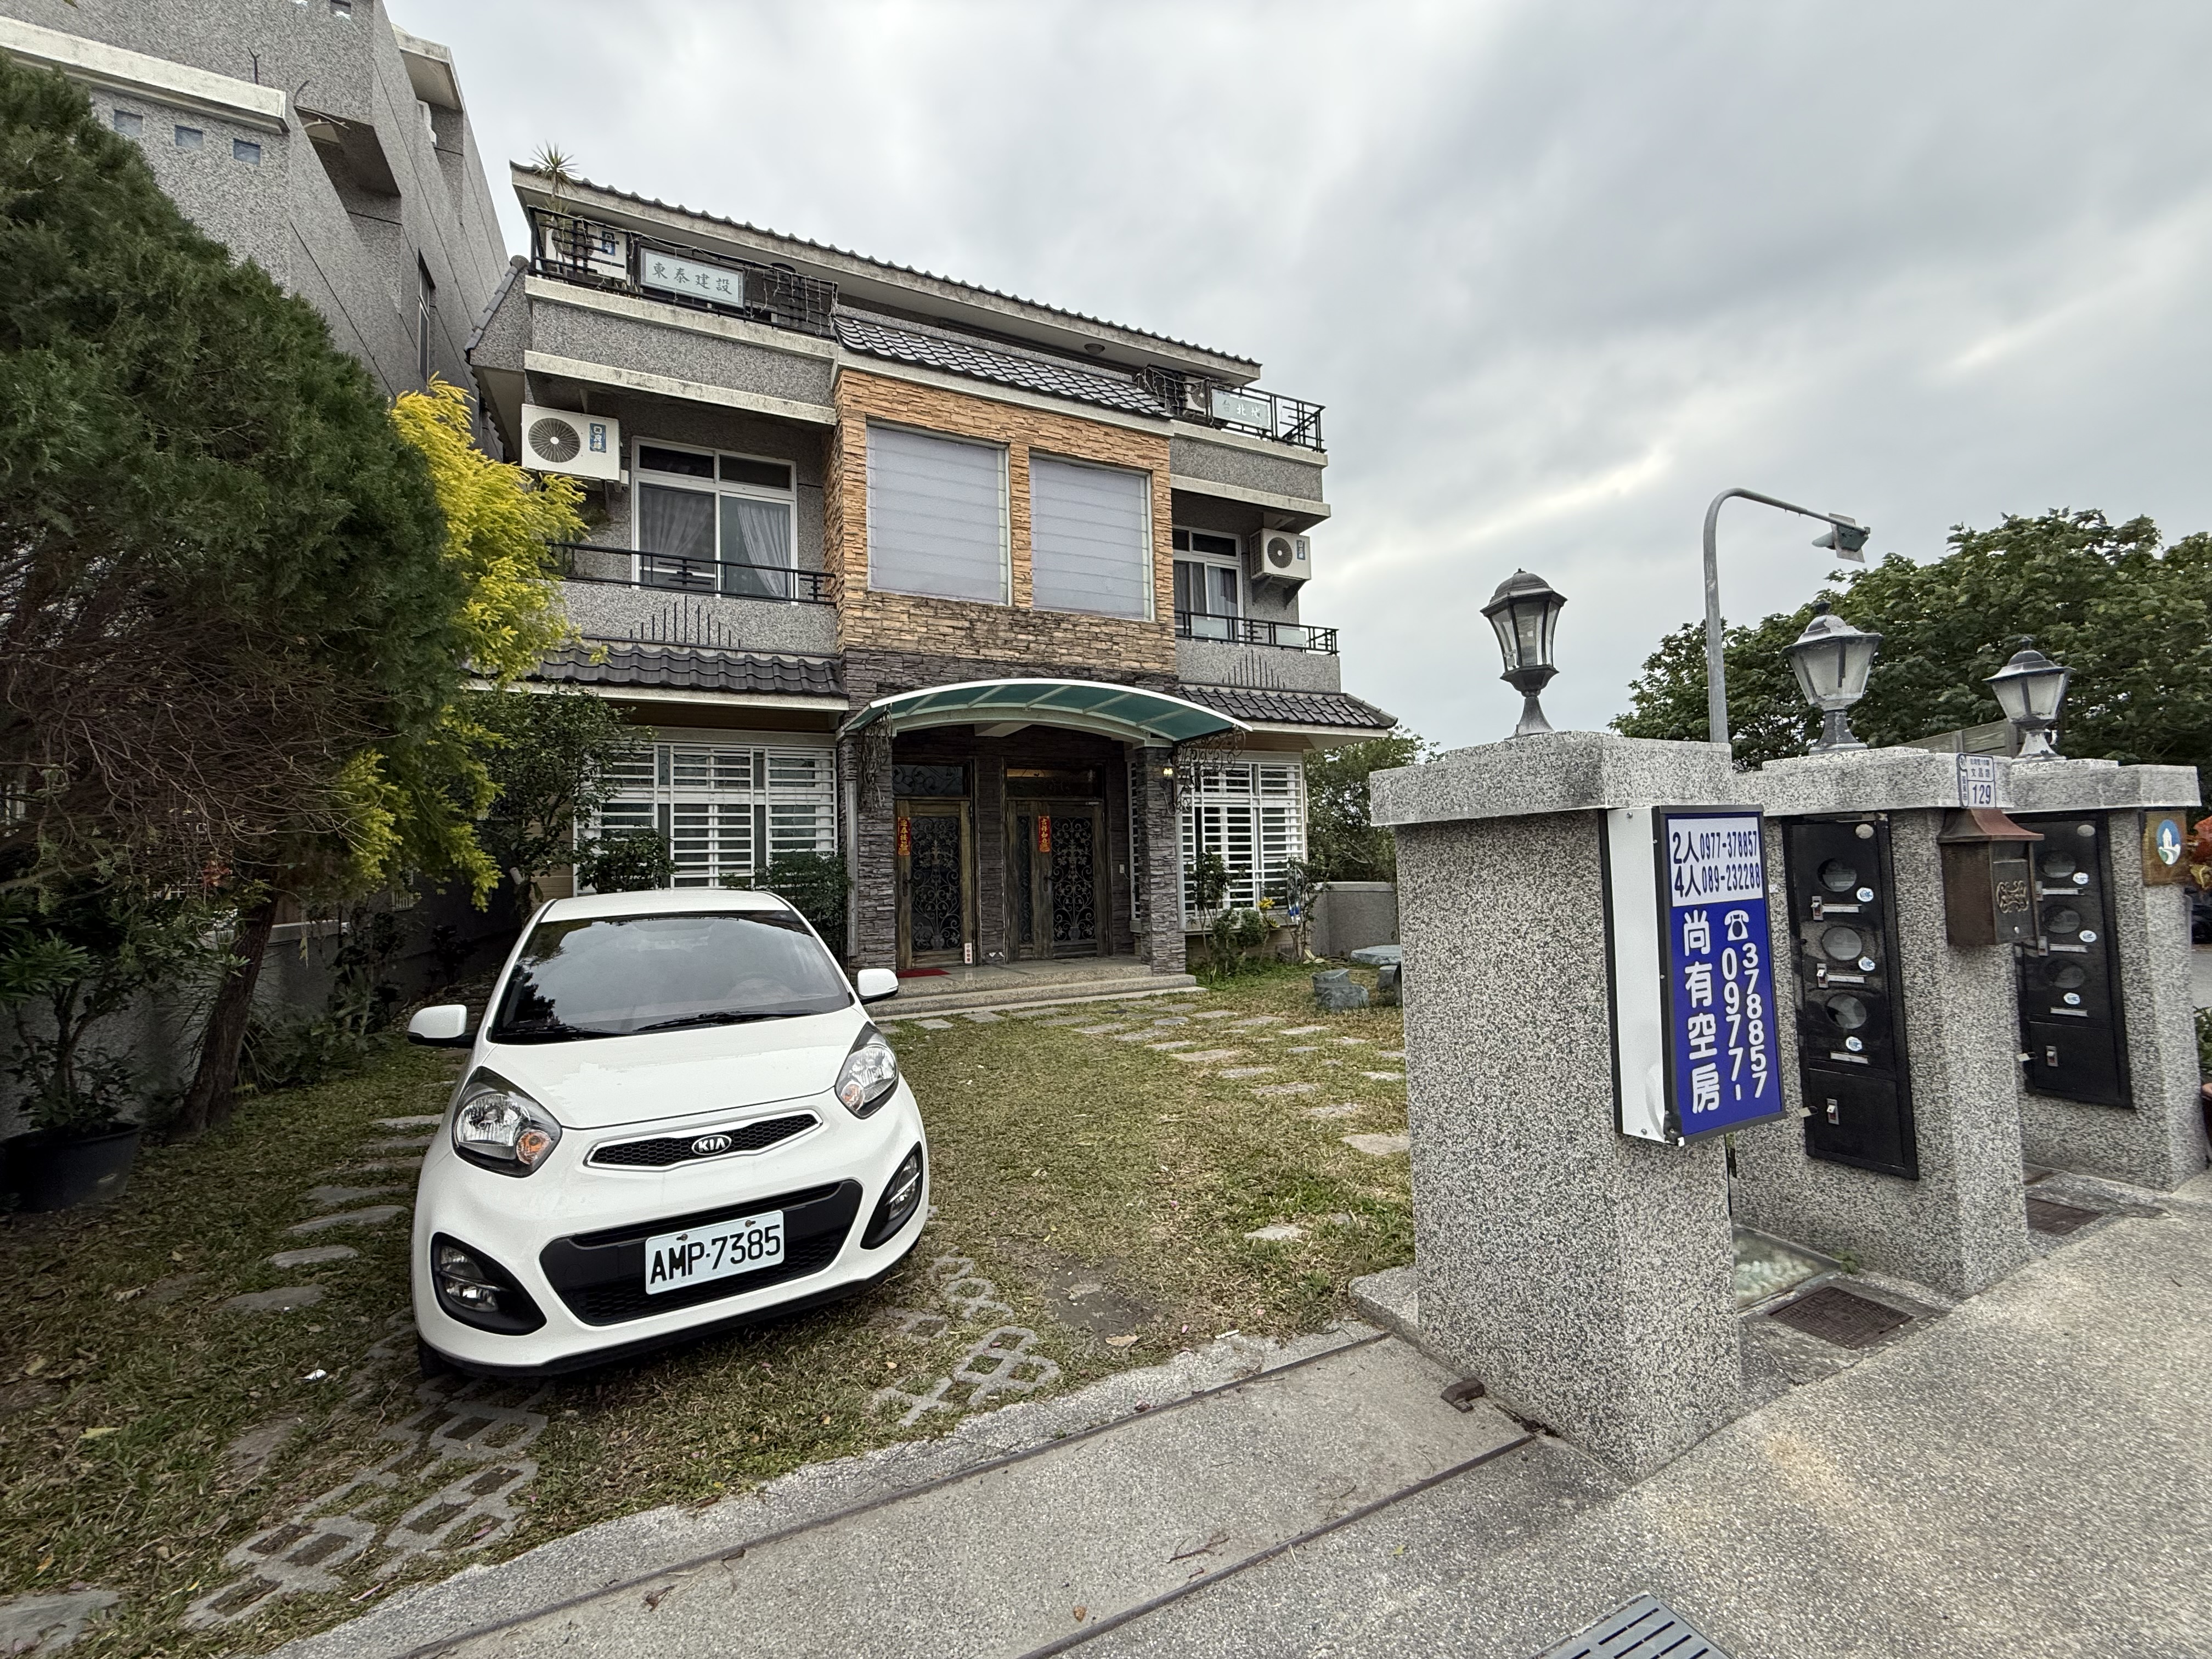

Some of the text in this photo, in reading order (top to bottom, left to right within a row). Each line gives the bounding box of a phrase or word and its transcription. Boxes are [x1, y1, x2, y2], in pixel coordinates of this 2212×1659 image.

[652, 261, 733, 295] 東泰建設
[1972, 784, 1991, 804] 129
[1673, 831, 1757, 864] 2人 0977-378857
[1674, 862, 1760, 898] 4人 089-232288
[1683, 909, 1720, 1114] 尚有空房
[698, 1137, 726, 1153] KIA
[650, 1224, 781, 1285] AMP-7385
